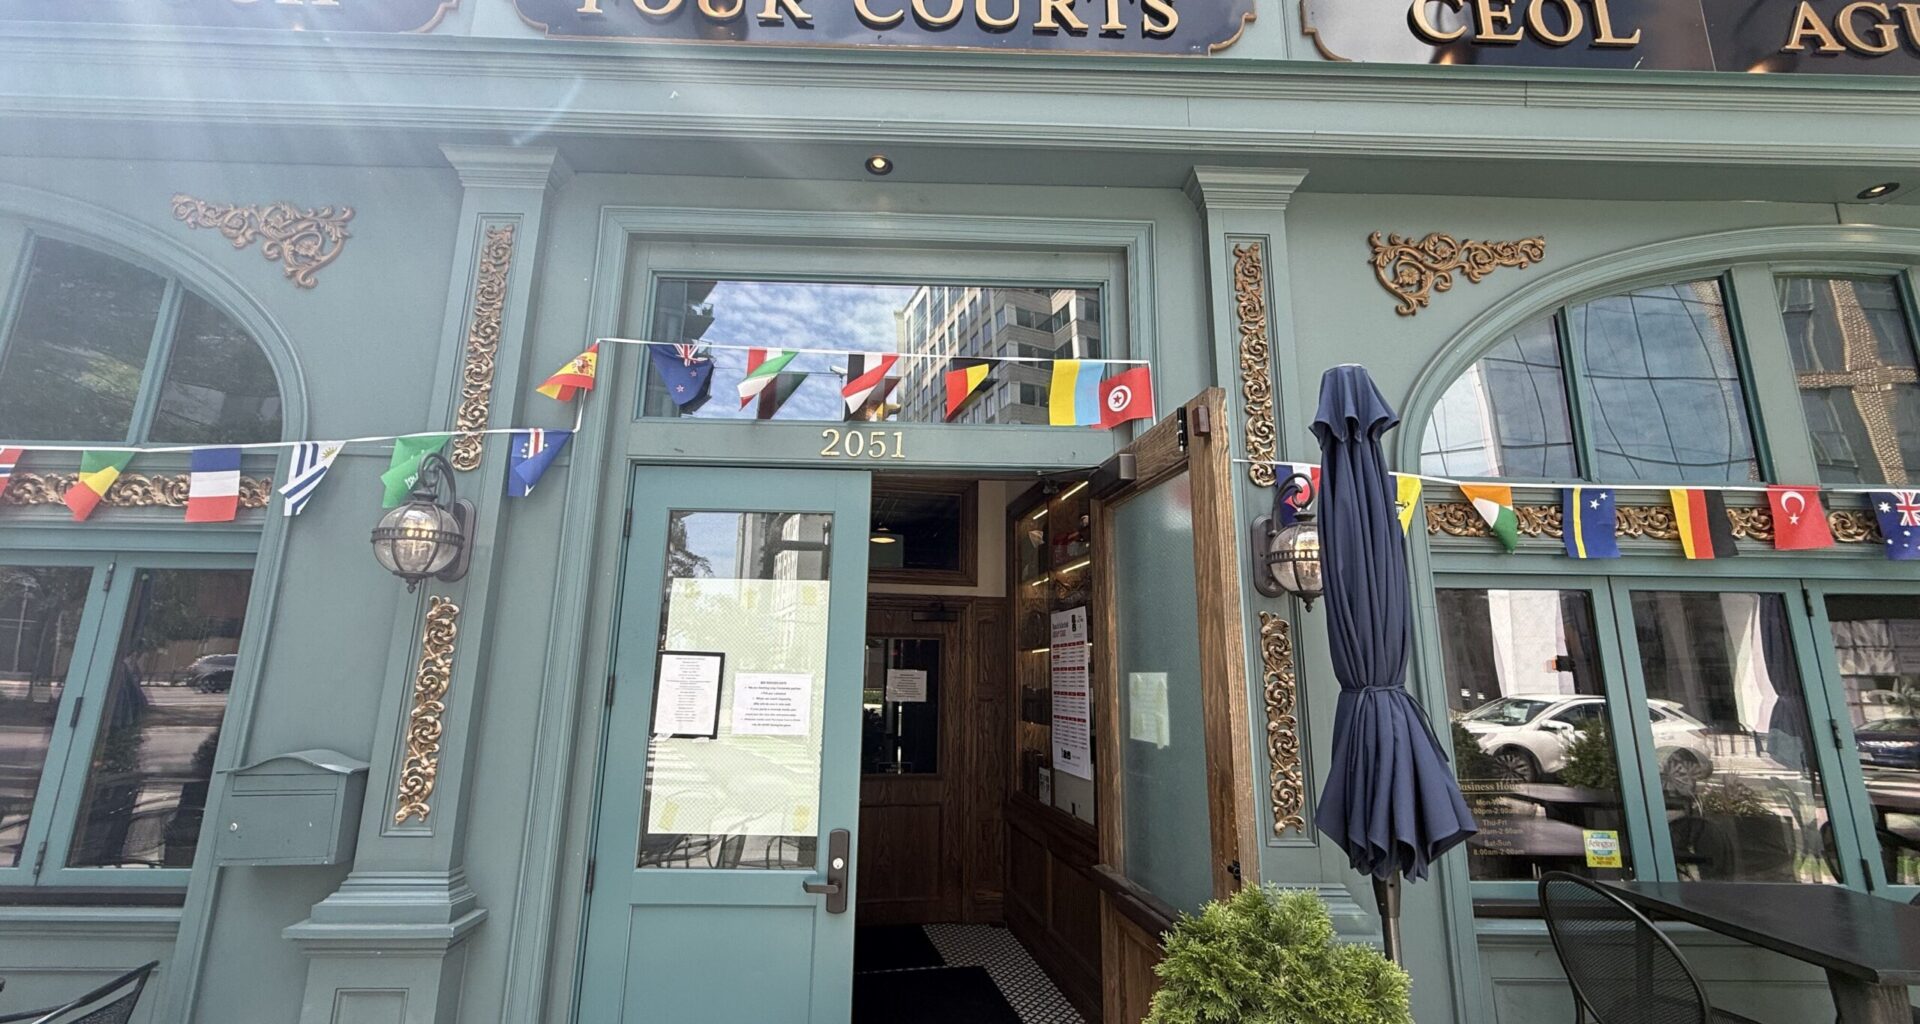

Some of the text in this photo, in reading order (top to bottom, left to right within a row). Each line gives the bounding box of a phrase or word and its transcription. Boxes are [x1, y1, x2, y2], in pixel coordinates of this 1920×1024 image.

[1409, 0, 1641, 45] CEOL
[820, 428, 906, 458] 2051
[1458, 782, 1495, 791] usiness
